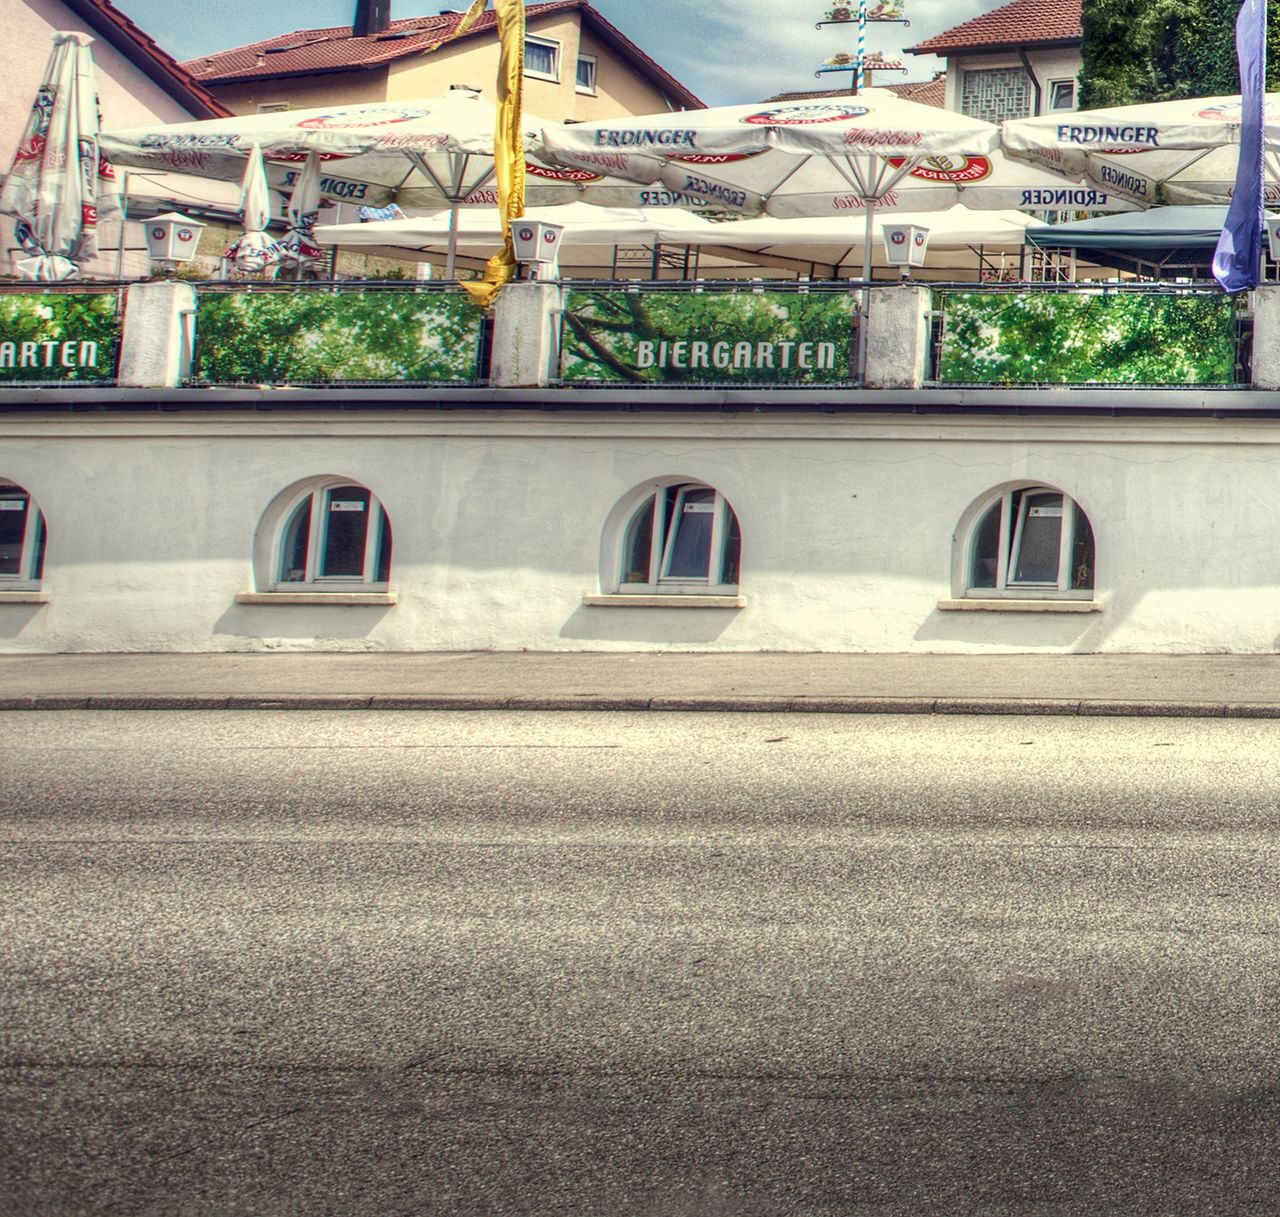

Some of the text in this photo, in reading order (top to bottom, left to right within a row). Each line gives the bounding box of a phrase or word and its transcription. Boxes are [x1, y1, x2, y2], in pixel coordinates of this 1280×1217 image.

[593, 128, 697, 148] ERDINGER
[1057, 125, 1160, 146] ERDINGER
[637, 341, 836, 369] BIERGARTEN
